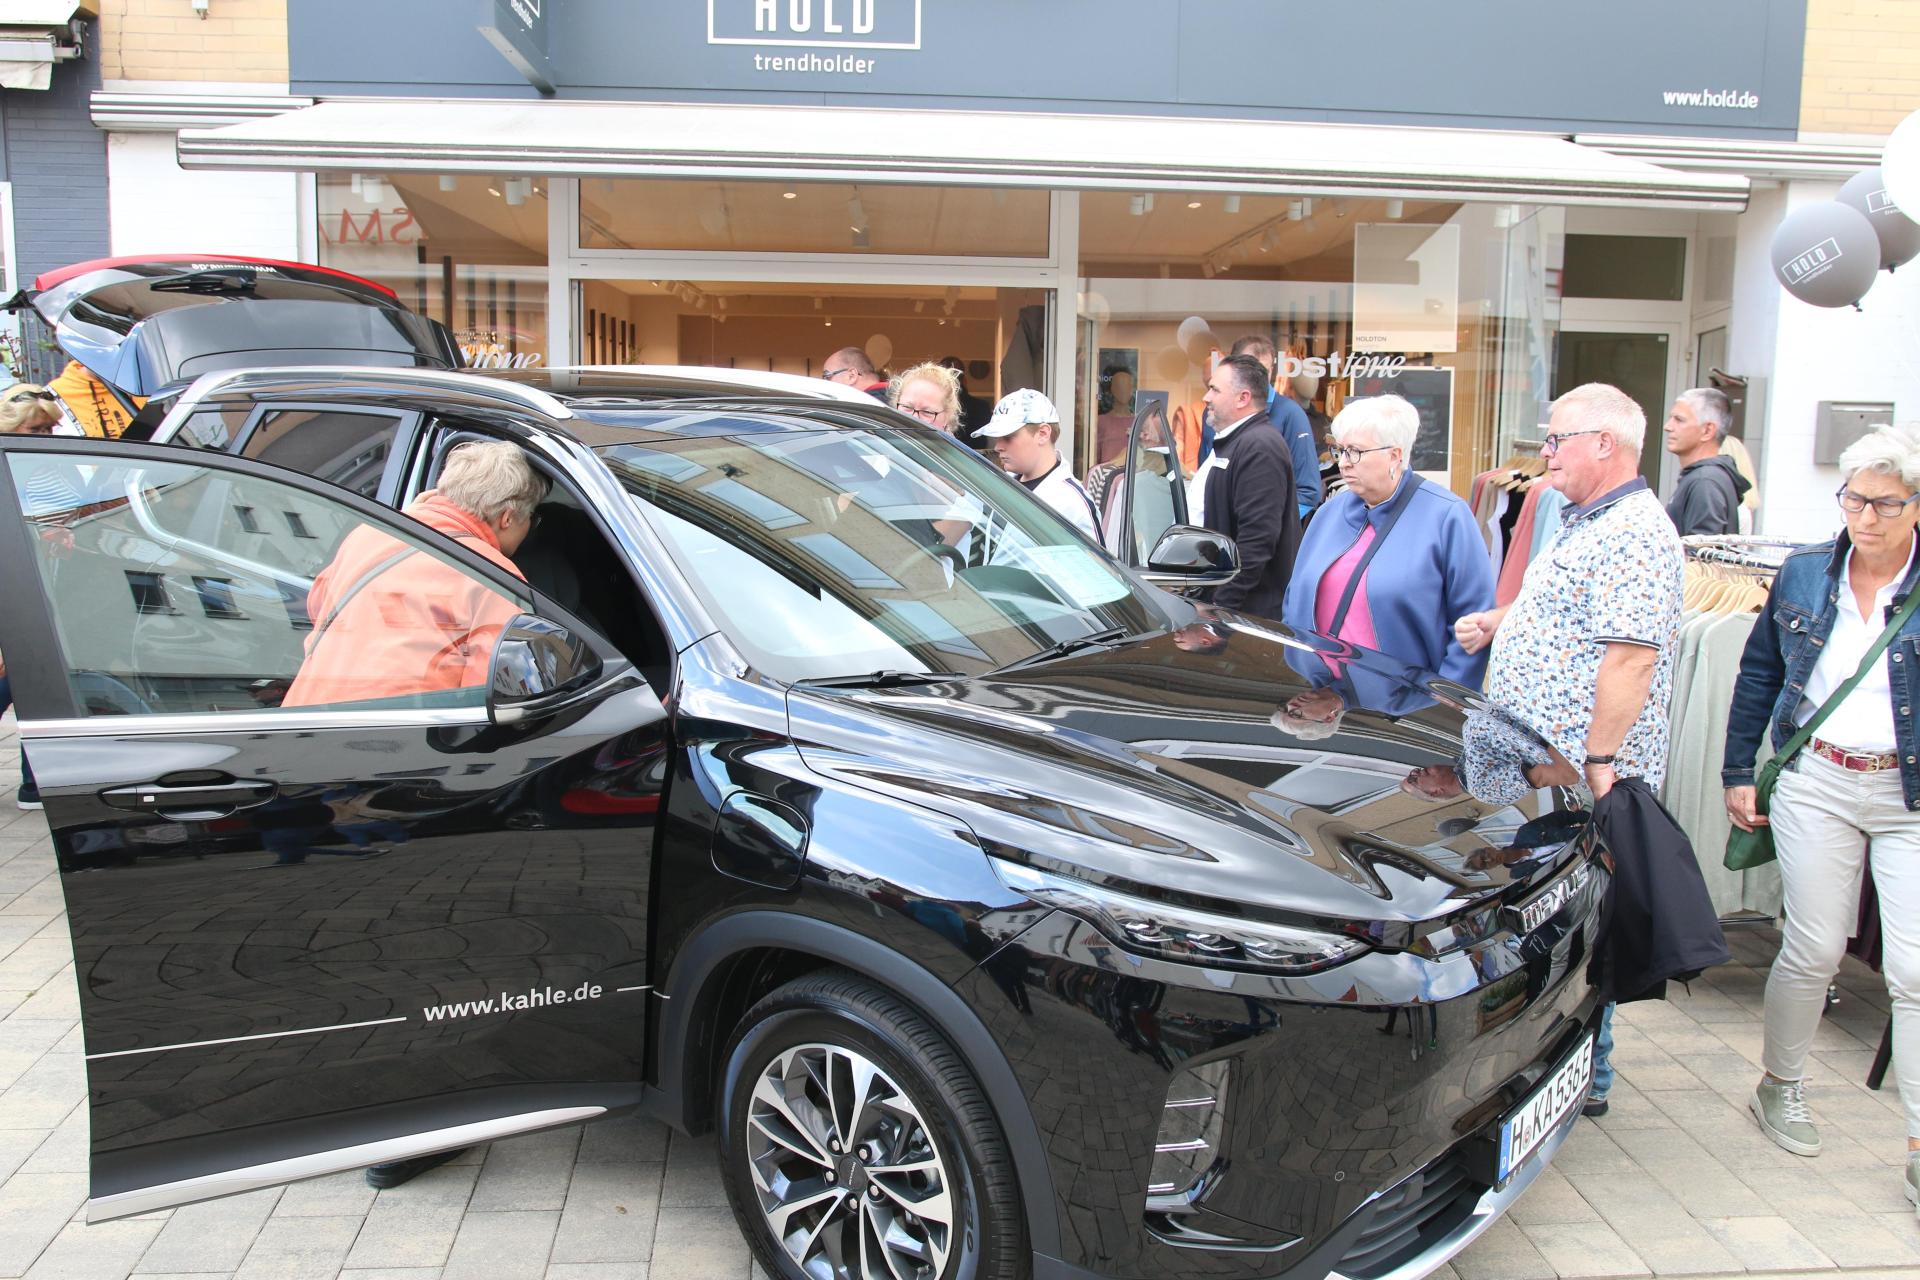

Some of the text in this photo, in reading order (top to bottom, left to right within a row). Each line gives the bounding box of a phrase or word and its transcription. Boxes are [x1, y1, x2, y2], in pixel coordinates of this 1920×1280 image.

[754, 53, 875, 74] trendholder
[1663, 88, 1759, 109] www.hold.de
[1791, 247, 1827, 276] HOLD
[1521, 862, 1589, 933] MAXUS
[423, 982, 603, 1021] www.kahle.de
[1511, 1115, 1524, 1163] H
